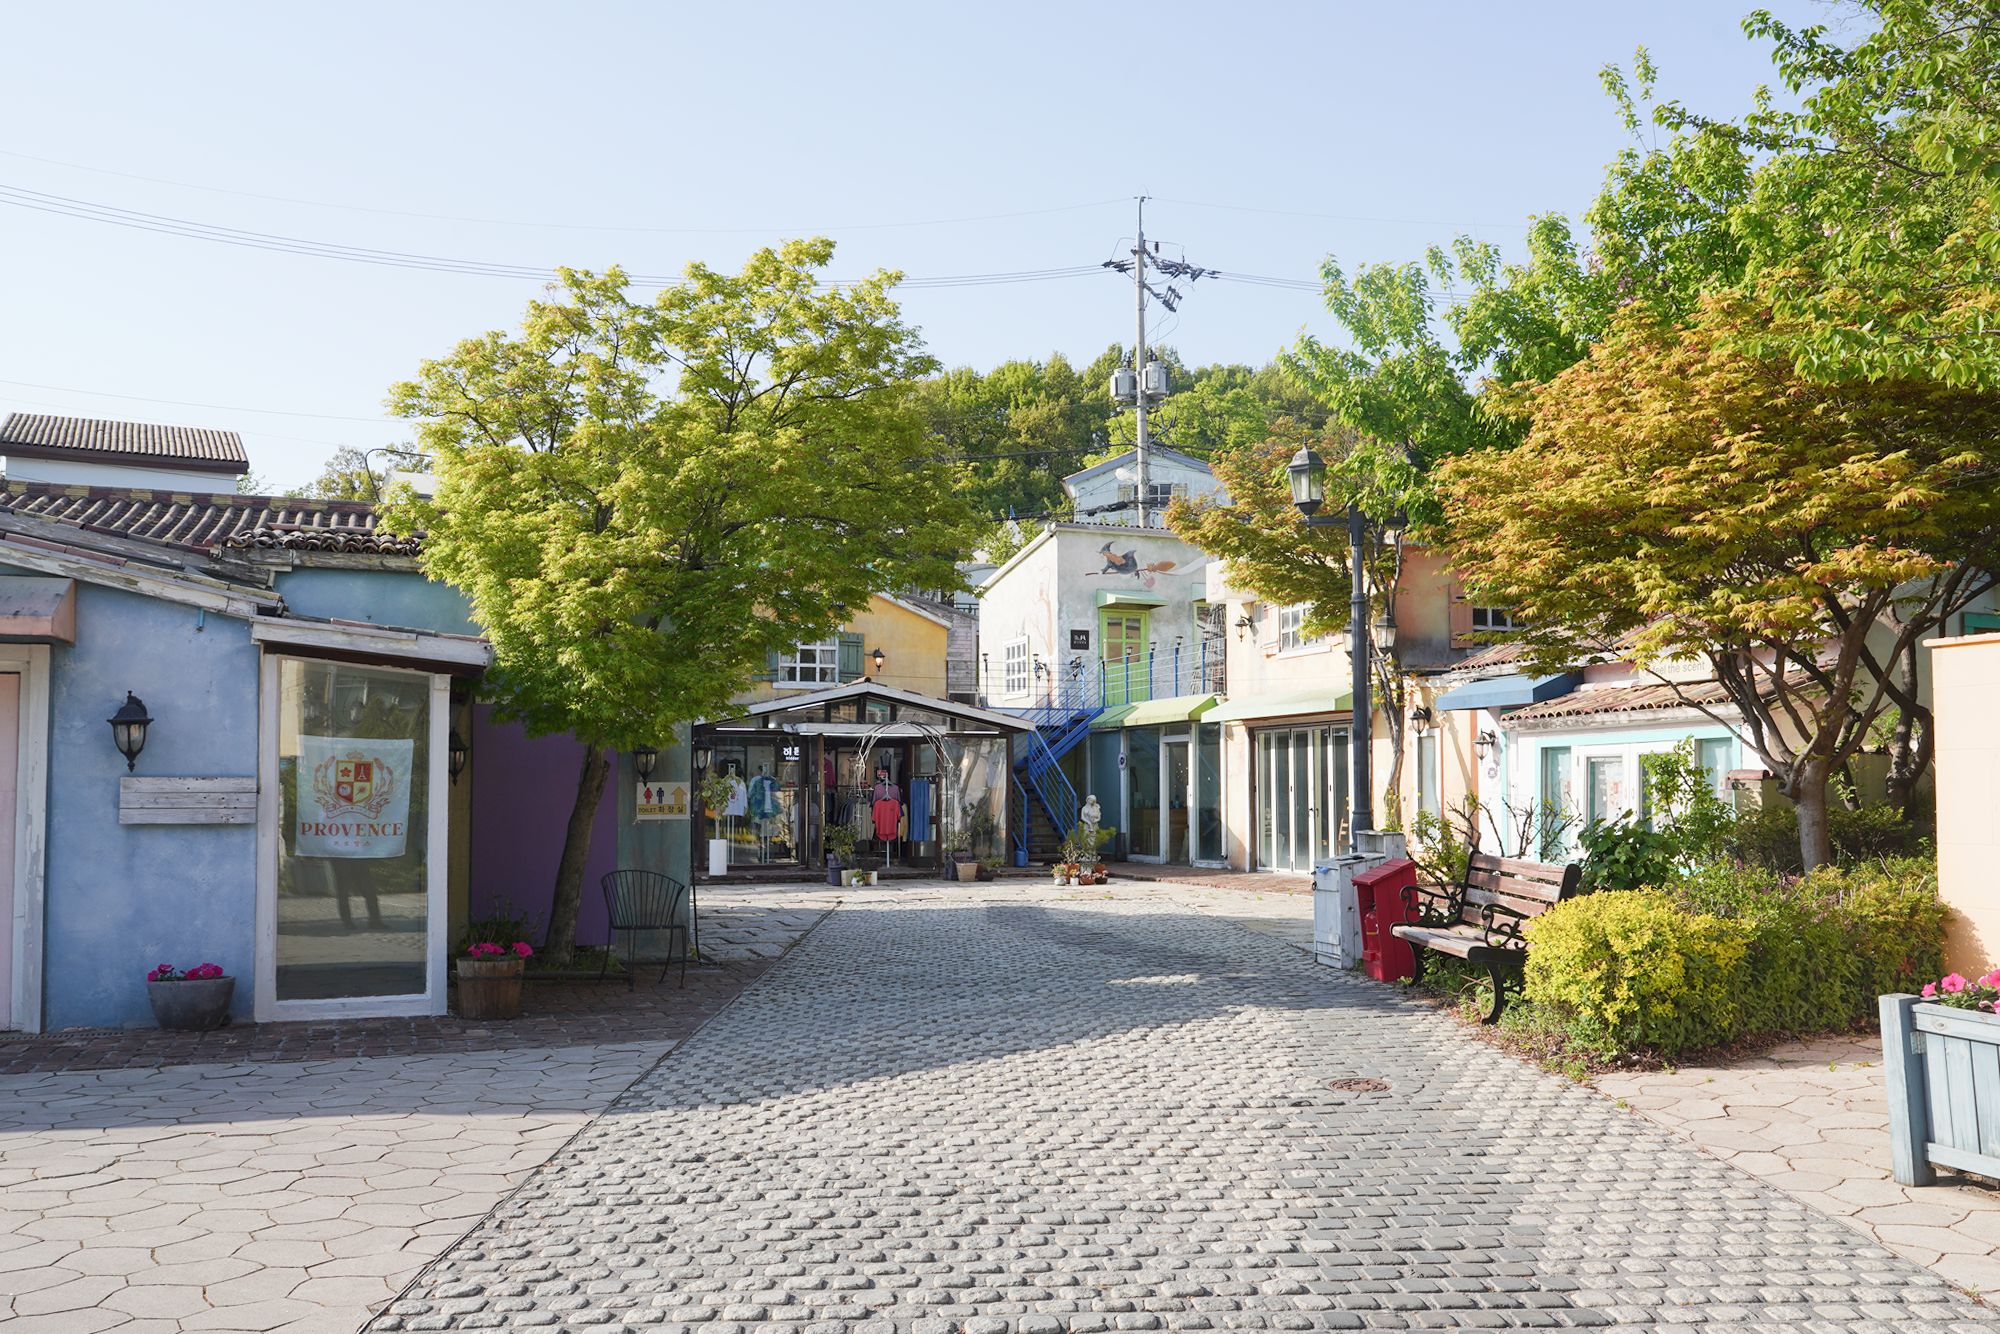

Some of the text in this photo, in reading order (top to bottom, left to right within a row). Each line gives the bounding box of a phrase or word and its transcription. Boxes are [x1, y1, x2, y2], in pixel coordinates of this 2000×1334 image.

[1668, 663, 1680, 673] the
[1682, 662, 1705, 673] scent
[300, 822, 404, 837] PROVENCE
